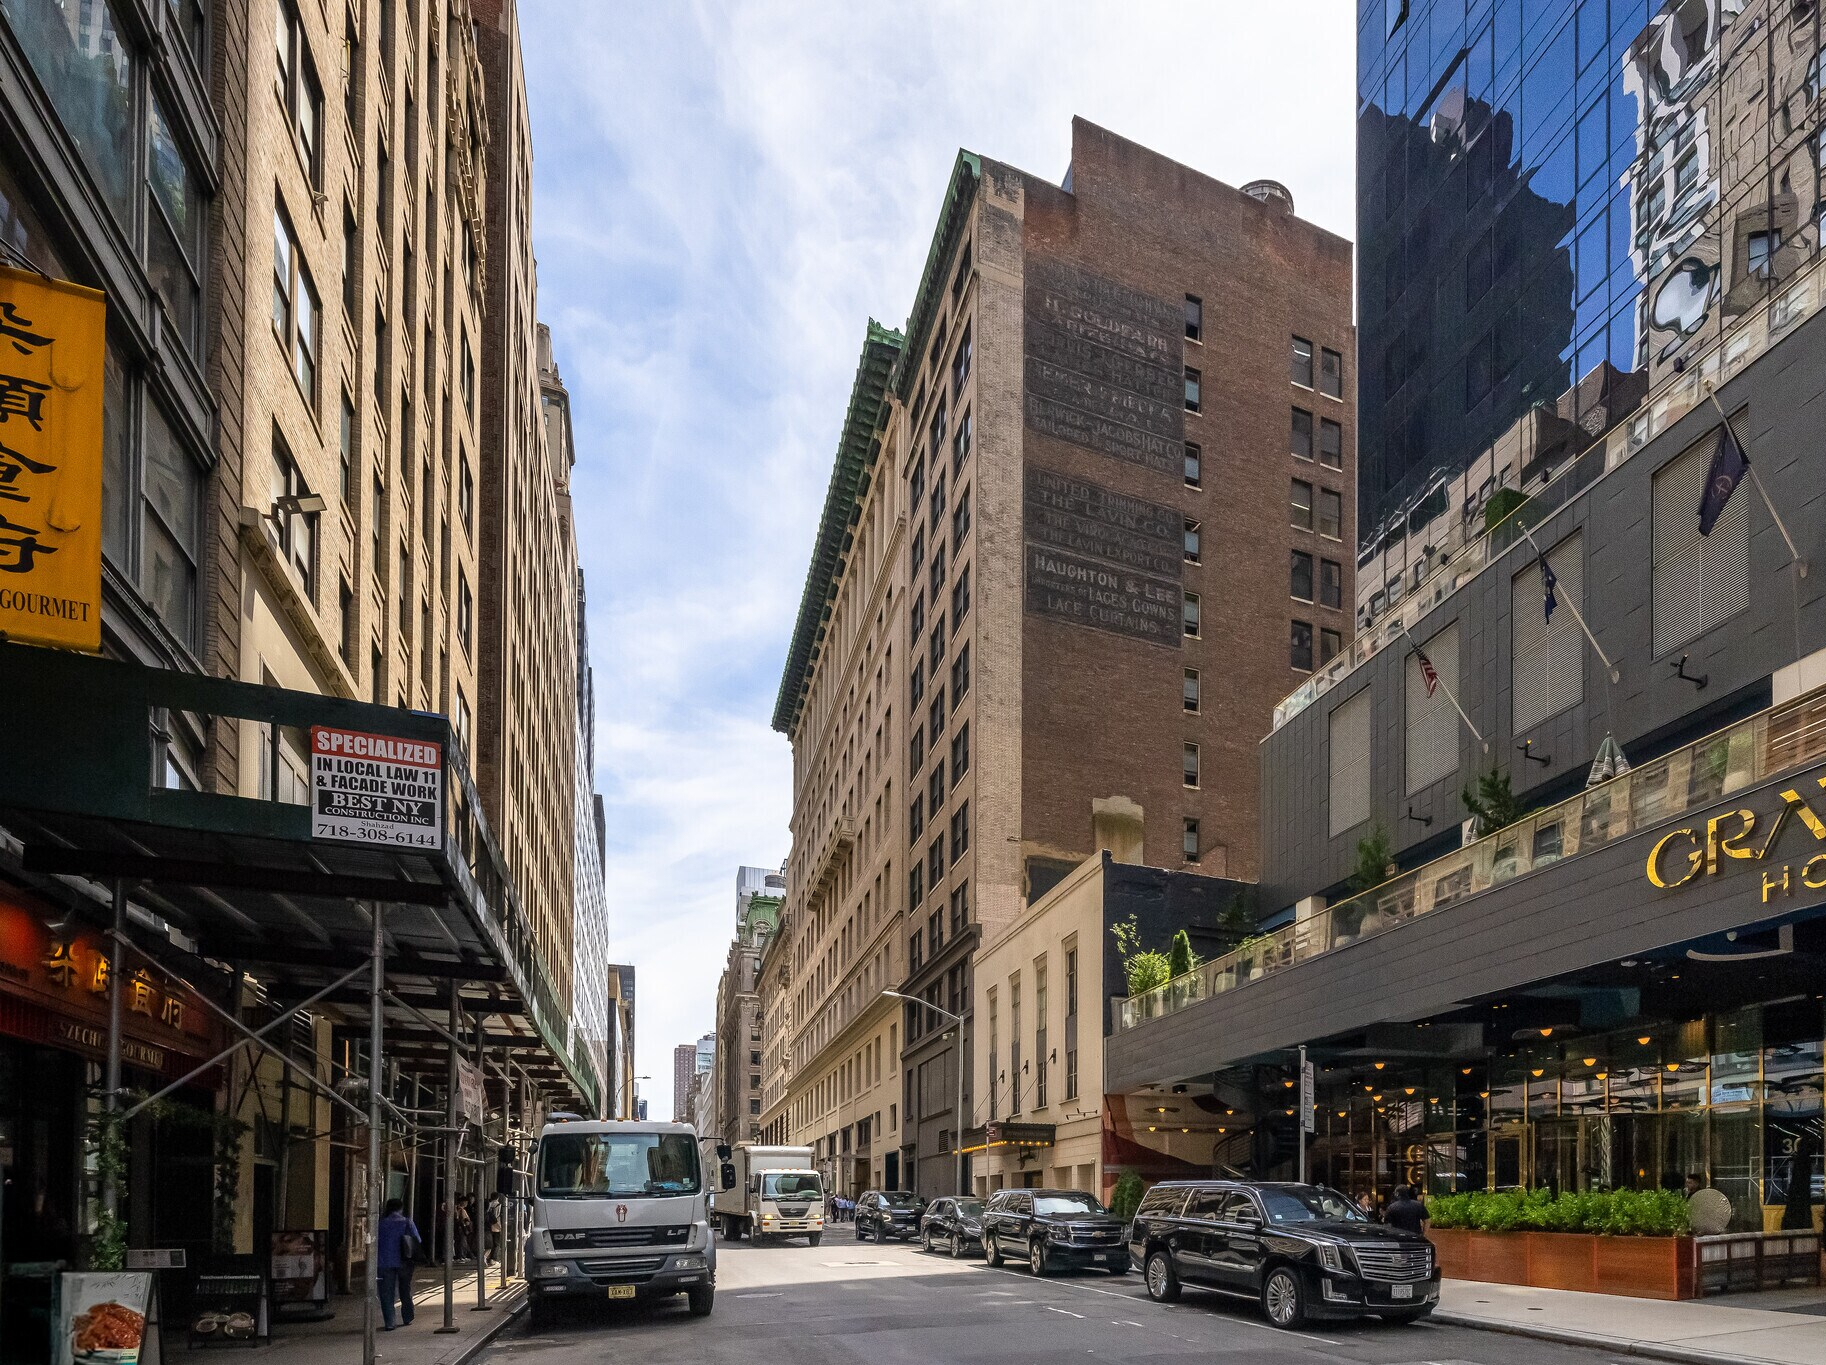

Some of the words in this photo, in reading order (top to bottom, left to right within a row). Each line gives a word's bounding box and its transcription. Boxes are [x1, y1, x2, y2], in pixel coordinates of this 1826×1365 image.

[1037, 473, 1089, 500] UNITED
[1100, 491, 1152, 518] TRIMMING
[1041, 489, 1074, 511] THE
[1085, 502, 1136, 528] LAVIN
[1034, 553, 1117, 589] HAUGHTON
[1125, 577, 1139, 595] &
[1144, 582, 1175, 604] LEE
[0, 588, 90, 622] GOURMET
[1047, 594, 1083, 617] LACE
[1089, 604, 1157, 634] CURTAINS
[317, 731, 437, 765] SPECIALIZED
[316, 757, 332, 772] IN
[337, 760, 383, 778] LOCAL
[386, 765, 419, 783] LAW
[422, 771, 436, 785] 11
[316, 775, 327, 787] &
[331, 774, 388, 794] FACADE
[391, 781, 438, 801] WORK
[324, 806, 408, 823] CONSTRUCTION
[410, 816, 430, 825] INC
[331, 792, 387, 811] BEST
[392, 799, 423, 815] NY
[317, 823, 436, 846] 718-308-6144
[361, 820, 395, 830] Shahzad
[1646, 777, 1826, 889] GRA
[59, 1020, 109, 1051] SZECHU
[553, 1233, 586, 1241] DAF
[666, 1228, 688, 1236] LF
